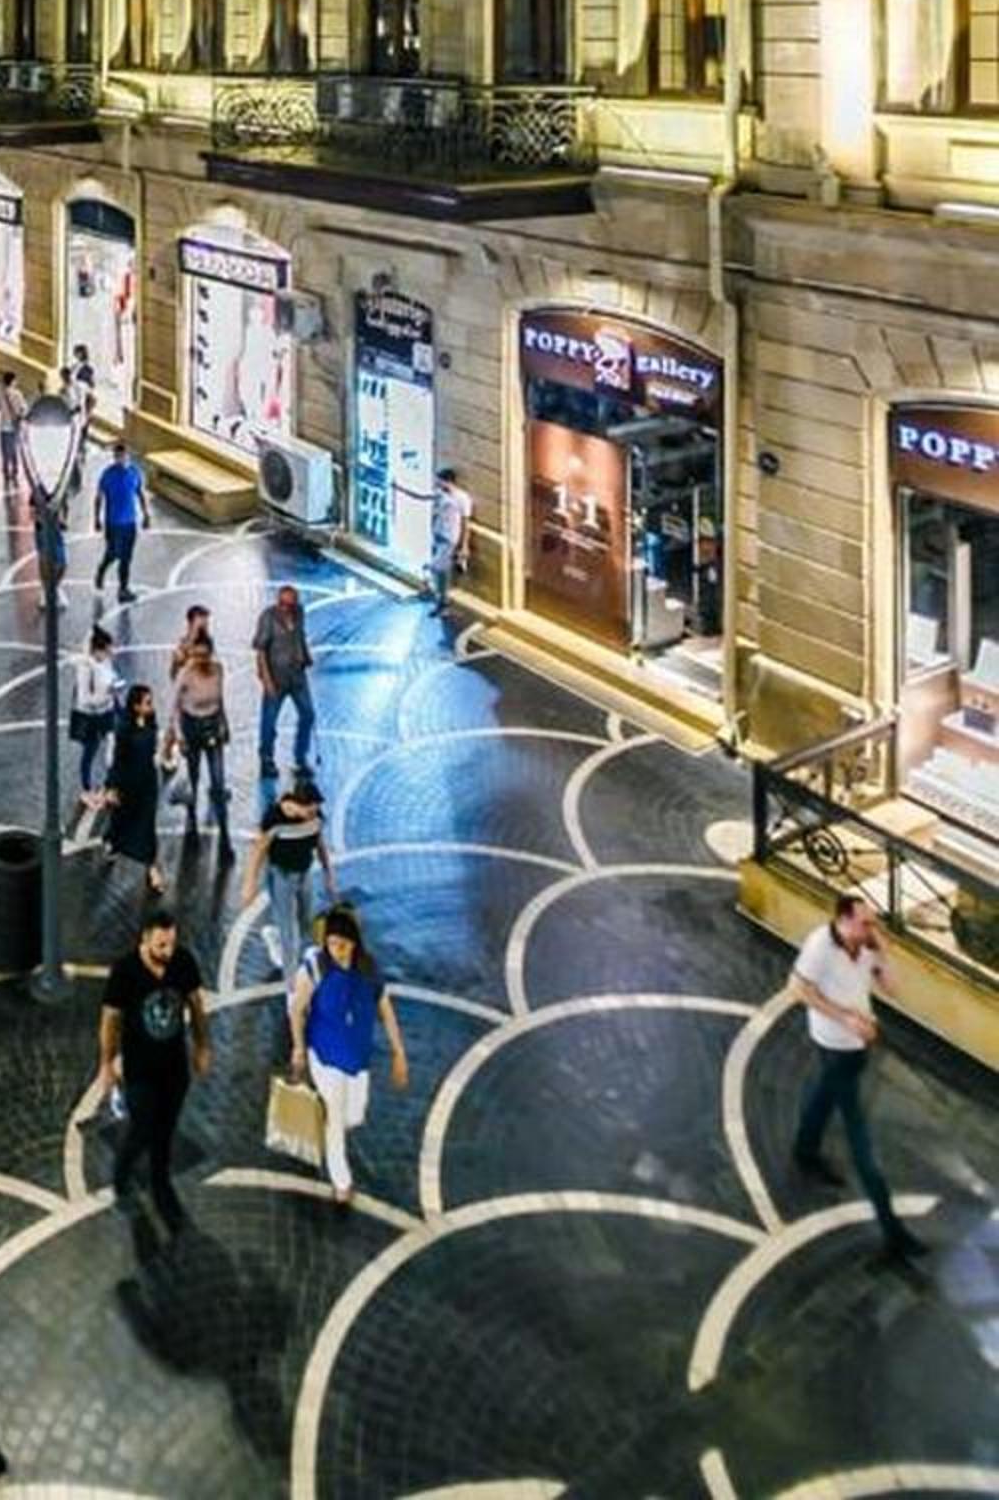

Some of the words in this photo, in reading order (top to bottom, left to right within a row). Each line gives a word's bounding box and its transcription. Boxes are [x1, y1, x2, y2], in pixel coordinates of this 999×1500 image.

[524, 327, 599, 363] POPPY
[636, 355, 714, 389] gallery
[898, 424, 999, 471] POPP
